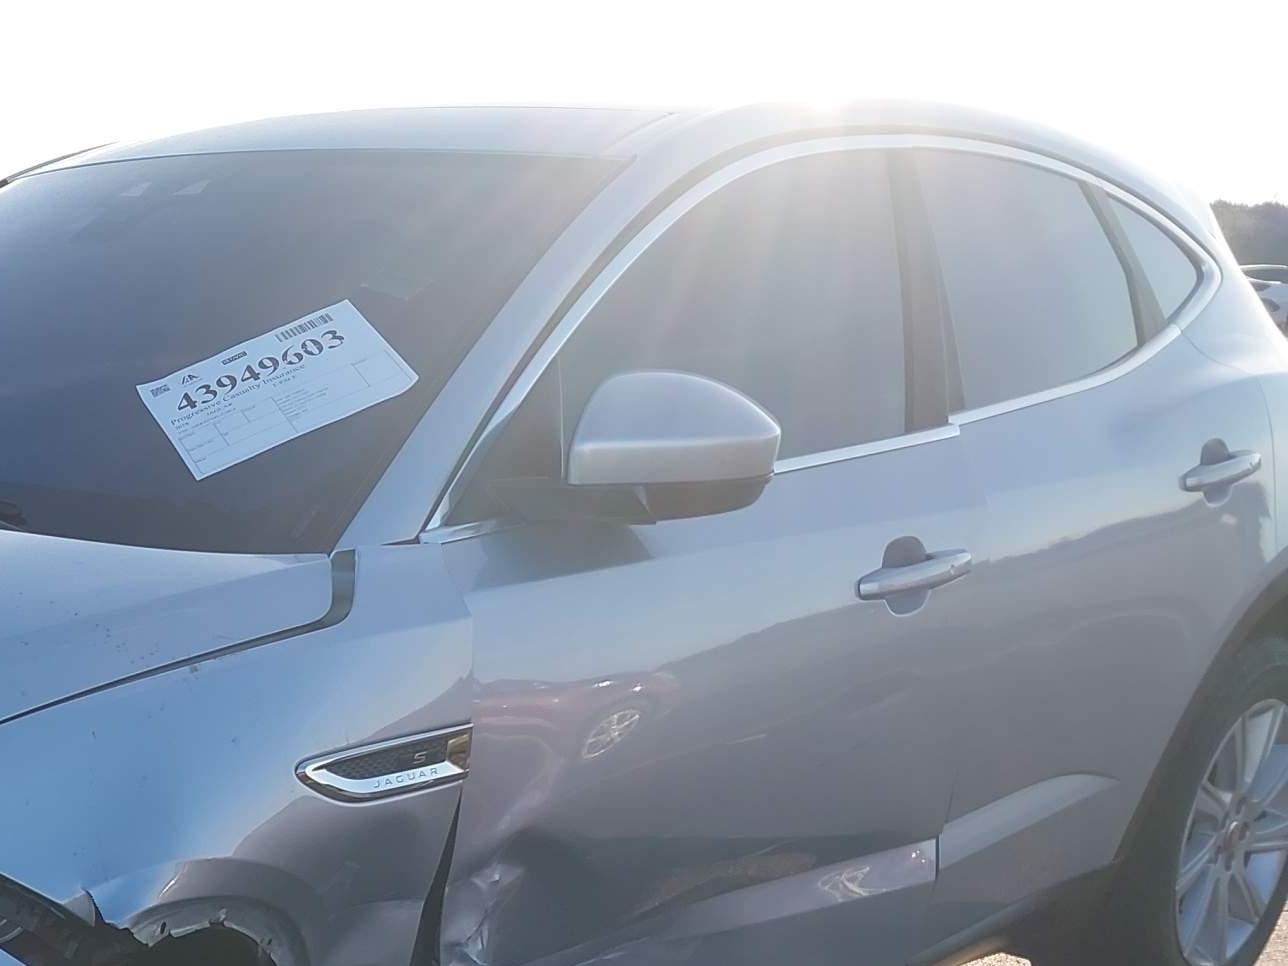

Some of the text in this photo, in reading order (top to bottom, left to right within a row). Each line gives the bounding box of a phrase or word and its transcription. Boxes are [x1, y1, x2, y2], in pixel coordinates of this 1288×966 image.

[178, 330, 344, 410] 43949603
[413, 752, 427, 764] S
[373, 767, 439, 789] JAGUAR
